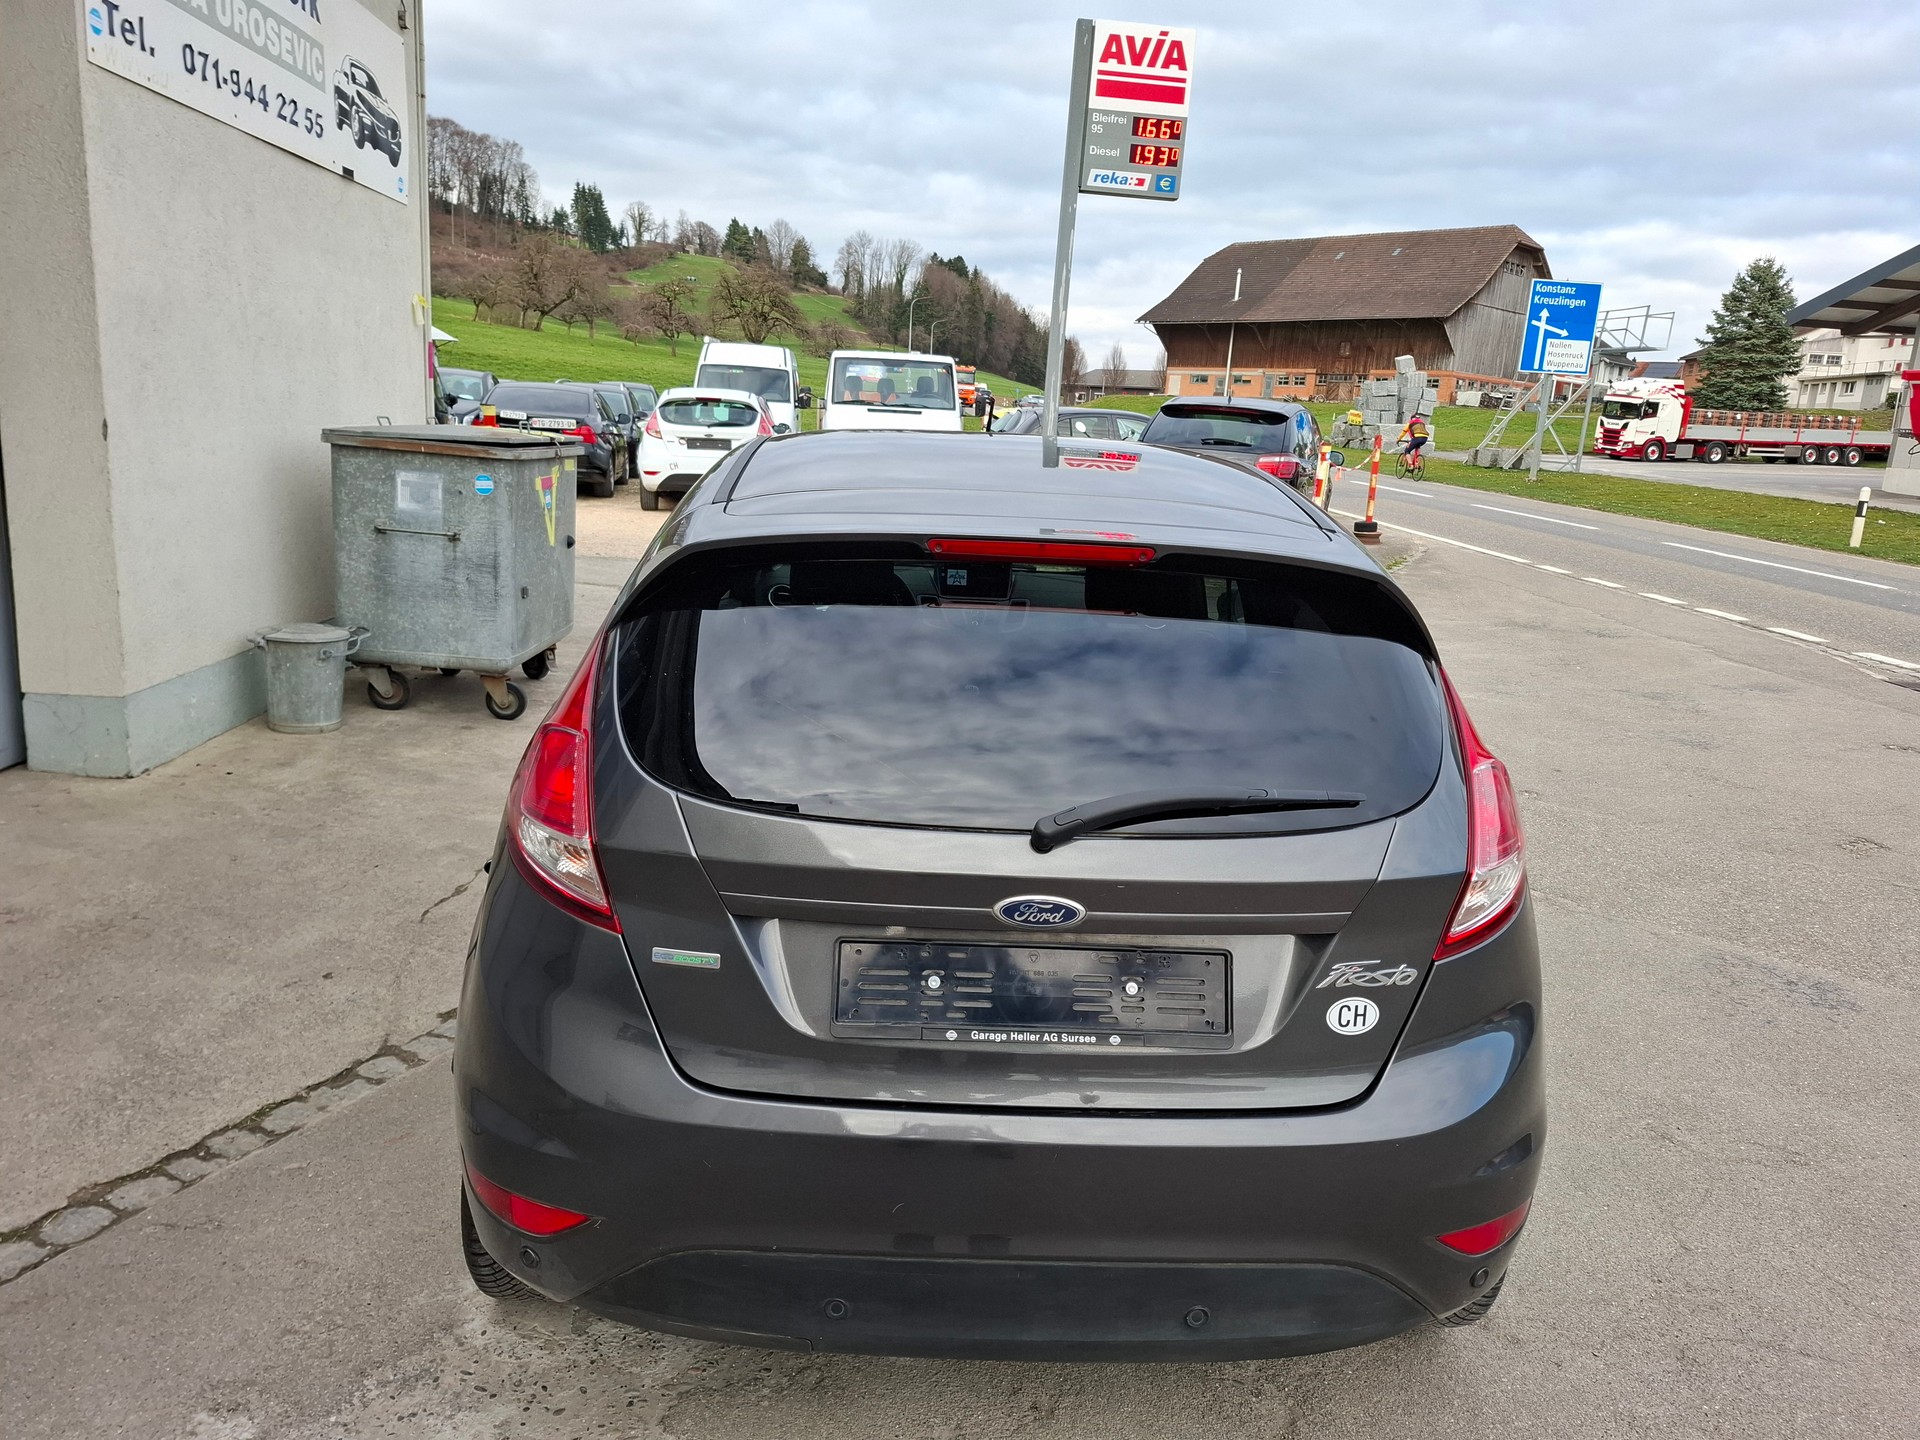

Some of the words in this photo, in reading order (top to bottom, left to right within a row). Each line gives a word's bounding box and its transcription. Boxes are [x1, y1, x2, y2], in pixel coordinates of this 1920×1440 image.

[102, 0, 155, 57] Tel.
[276, 93, 299, 128] 22
[304, 108, 324, 139] 55
[1092, 112, 1127, 125] Bleifrei
[1091, 124, 1103, 134] 95
[1089, 145, 1120, 157] Diesel
[1535, 283, 1577, 295] Konstanz
[1534, 295, 1587, 308] Kreuzlingen
[1549, 341, 1572, 349] Nollen
[1548, 350, 1584, 359] Hosenruck
[1546, 360, 1584, 369] Wuppenau
[669, 462, 679, 471] CH
[1014, 902, 1066, 923] Ford
[1315, 959, 1418, 989] Fiesta
[1337, 1004, 1368, 1028] CH
[971, 1030, 1008, 1042] Garage
[1010, 1032, 1041, 1042] Heller
[1043, 1033, 1058, 1042] AG
[1061, 1033, 1097, 1043] Sursee
